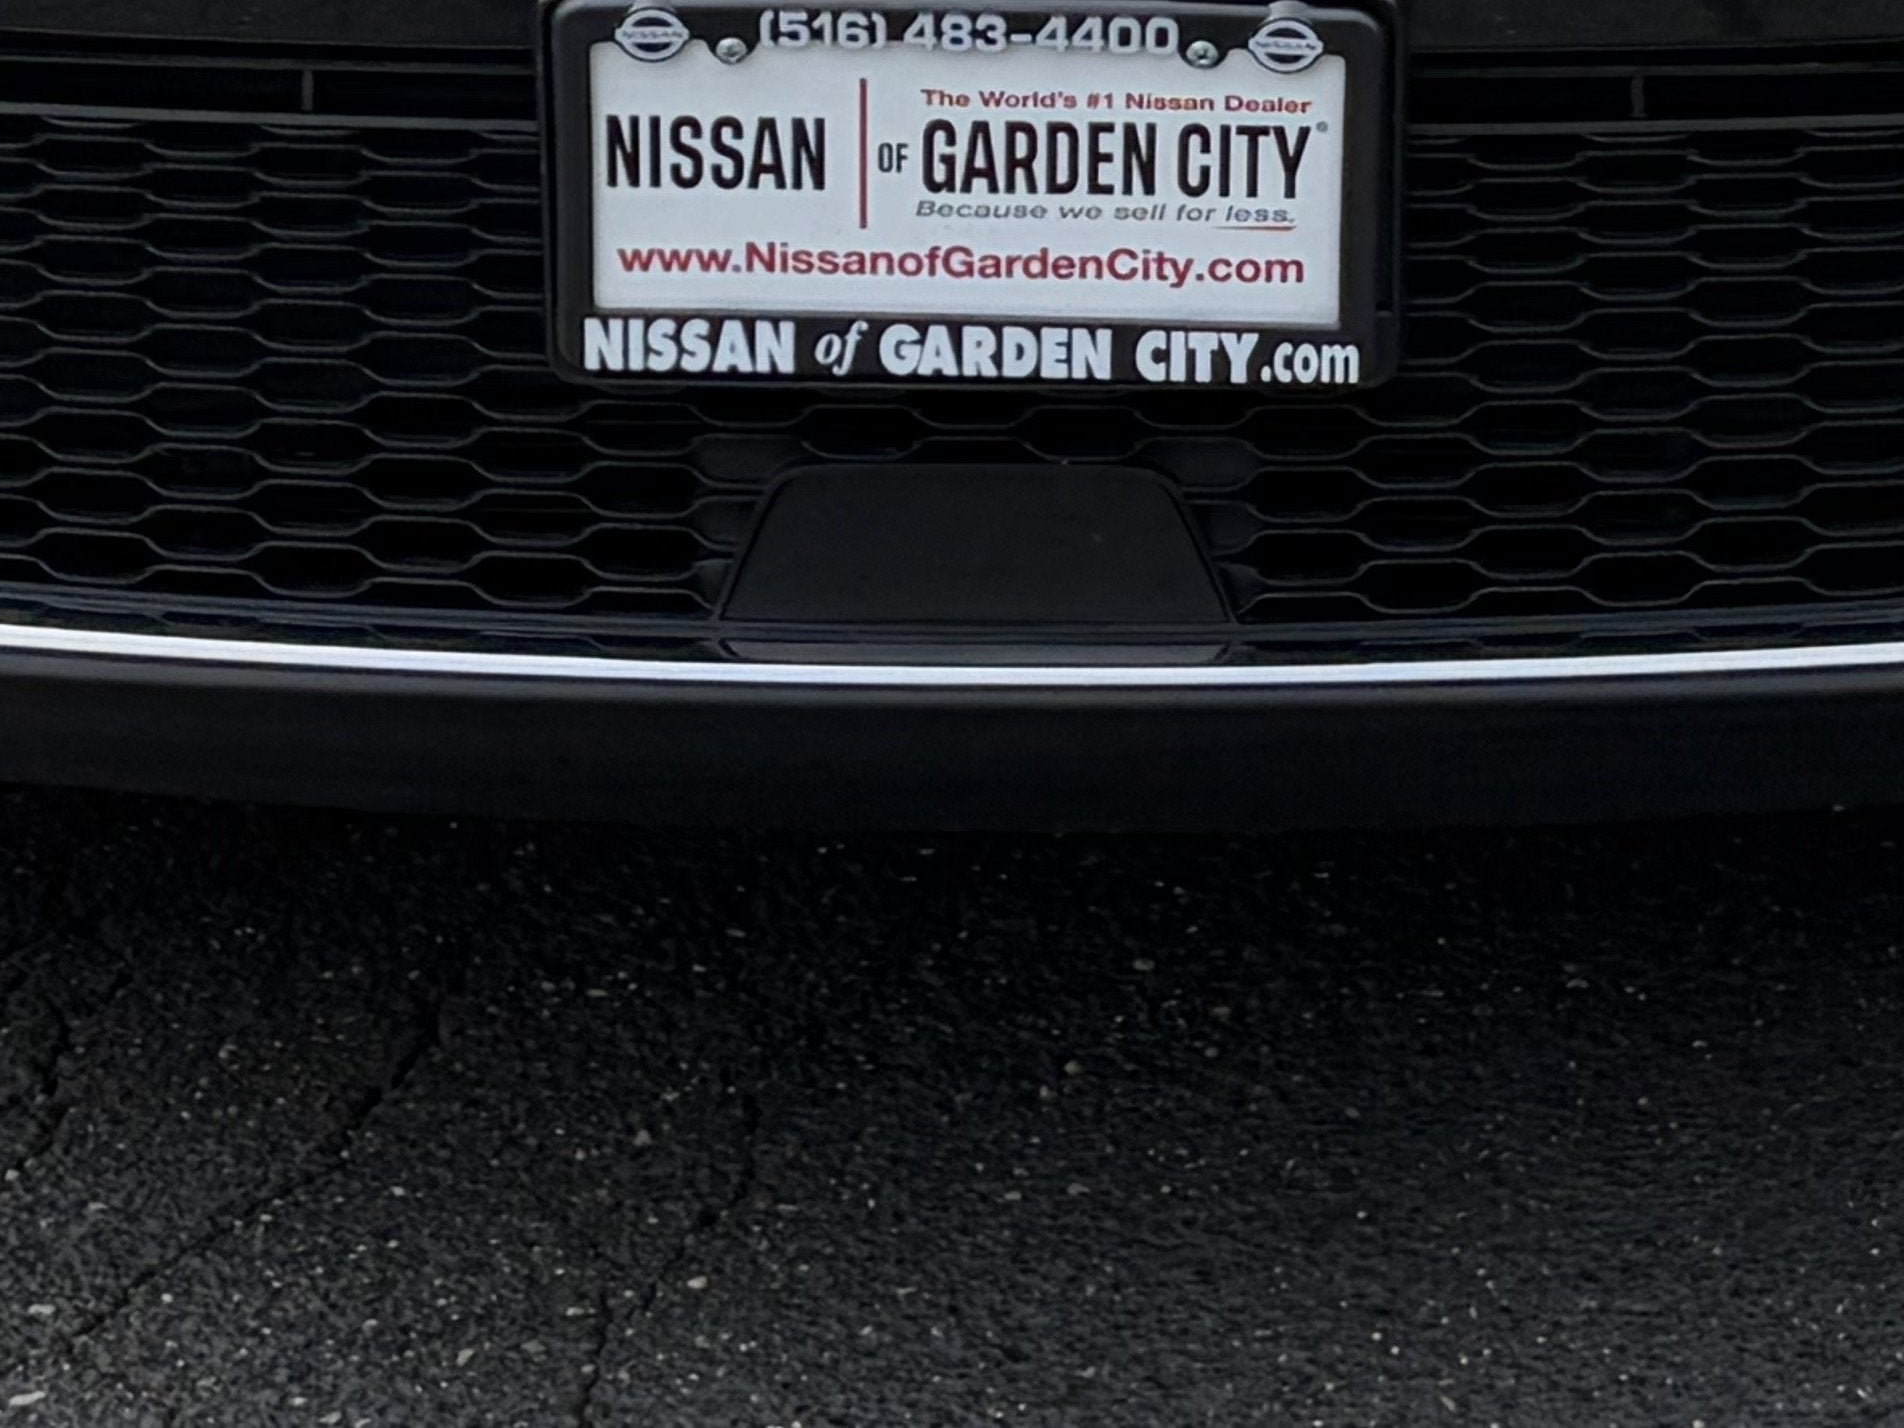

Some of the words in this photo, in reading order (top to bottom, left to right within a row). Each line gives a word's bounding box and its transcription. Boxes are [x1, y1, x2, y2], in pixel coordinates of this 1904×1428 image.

[759, 9, 887, 50] (516)
[903, 11, 1179, 55] 483-4400
[920, 88, 970, 108] The
[978, 90, 1078, 110] World's
[1086, 92, 1114, 110] #1
[1125, 92, 1215, 112] Nissan
[1224, 94, 1313, 114] Dealer
[605, 114, 826, 190] NISSAN
[877, 142, 909, 174] OF
[921, 118, 1157, 196] GARDEN
[1177, 123, 1312, 199] CITY
[915, 200, 1048, 220] Because
[1058, 205, 1103, 220] we
[1114, 203, 1167, 221] sell
[1176, 204, 1217, 223] for
[1225, 204, 1296, 224] less.
[617, 242, 1305, 288] www.NissanofGardenCity.com
[583, 317, 796, 374] NISSAN
[814, 320, 869, 376] of
[879, 324, 1113, 380] GARDEN
[1135, 329, 1359, 384] CITY.com
